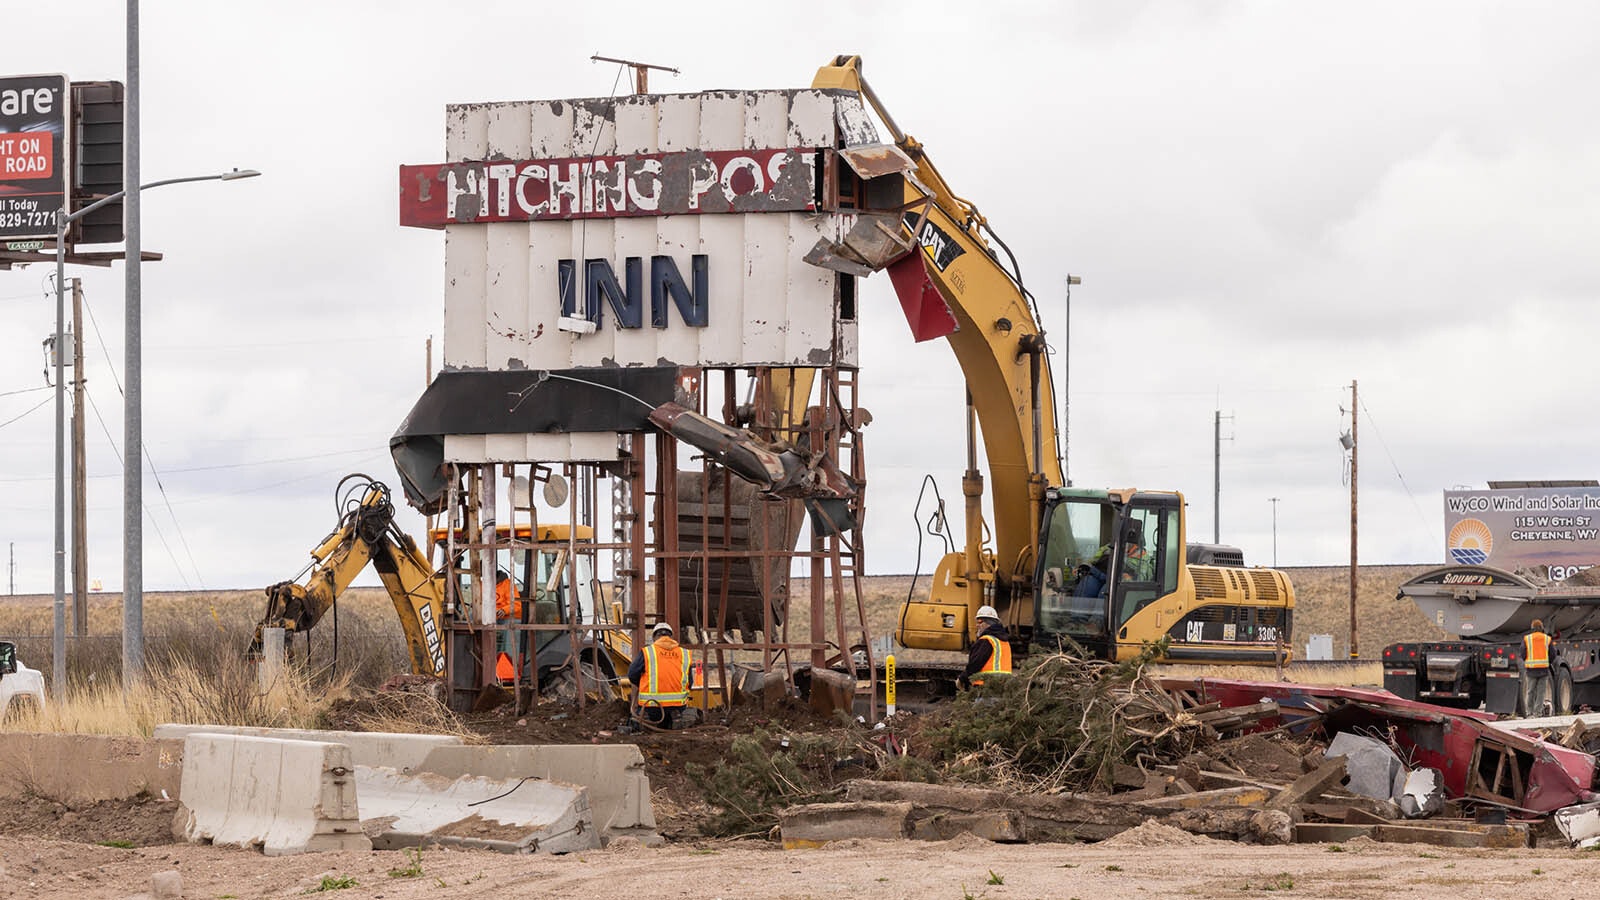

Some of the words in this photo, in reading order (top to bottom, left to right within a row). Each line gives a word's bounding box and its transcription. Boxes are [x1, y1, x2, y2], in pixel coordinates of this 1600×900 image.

[19, 138, 40, 155] ON
[6, 156, 47, 173] ROAD
[447, 159, 663, 218] HITCHING
[9, 199, 38, 212] Today
[921, 222, 946, 264] CAT
[558, 254, 709, 332] INN
[1448, 497, 1488, 512] WyCO
[1493, 496, 1523, 510] Wind
[1526, 496, 1548, 509] and
[1551, 496, 1581, 509] Solar
[1514, 517, 1535, 527] 115
[1536, 516, 1550, 527] W
[1577, 529, 1598, 540] WY
[419, 603, 445, 674] DEERE
[1186, 620, 1205, 642] CAT
